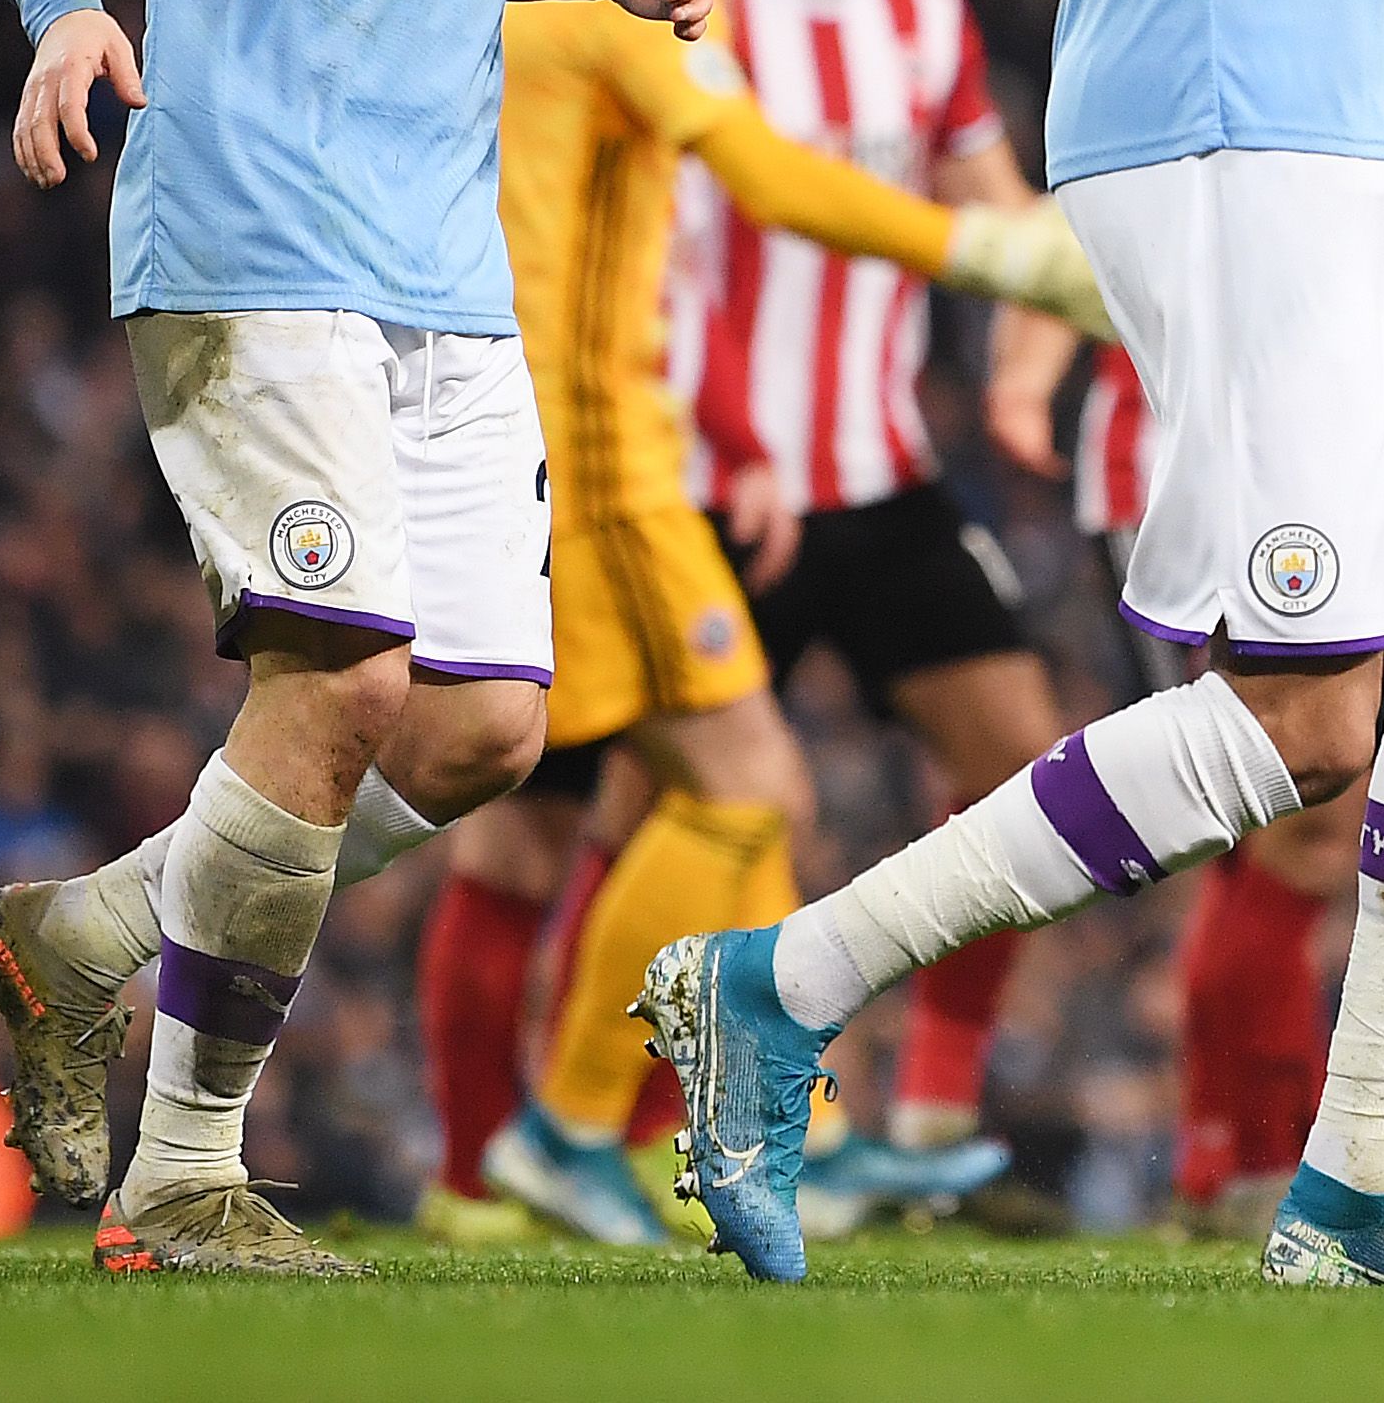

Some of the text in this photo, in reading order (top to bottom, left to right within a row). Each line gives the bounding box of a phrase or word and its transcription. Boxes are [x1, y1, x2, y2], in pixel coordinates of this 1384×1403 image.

[276, 507, 342, 539] MANCHESTER
[1259, 531, 1329, 558] MANCHESTER
[303, 572, 327, 584] CITY
[1282, 600, 1308, 610] CITY
